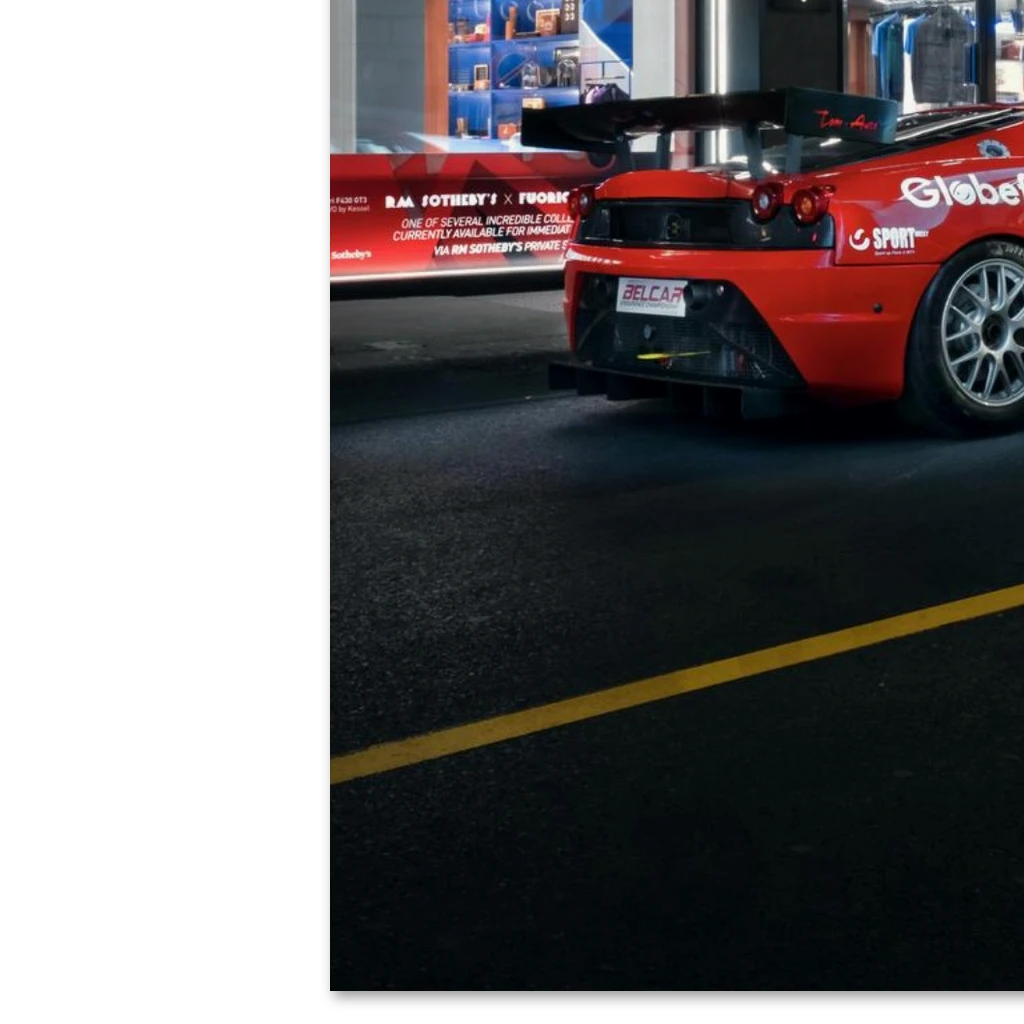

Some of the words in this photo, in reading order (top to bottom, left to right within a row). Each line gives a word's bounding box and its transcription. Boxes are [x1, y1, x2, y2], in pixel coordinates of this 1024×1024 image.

[385, 195, 415, 209] RM
[421, 192, 497, 207] SOTHEBY'S
[401, 218, 423, 229] ONE
[425, 217, 440, 228] OF
[440, 216, 483, 228] SEVERAL
[486, 214, 542, 226] INCREDIBLE
[393, 228, 452, 242] CURRENTLY
[452, 226, 504, 239] AVAILABLE
[506, 225, 526, 237] FOR
[872, 227, 915, 250] SPORT
[434, 245, 450, 256] VIA
[451, 244, 468, 255] RM
[469, 241, 523, 255] SOTHEBY'S
[524, 240, 560, 251] PRIVATE
[623, 284, 684, 303] BELCAR
